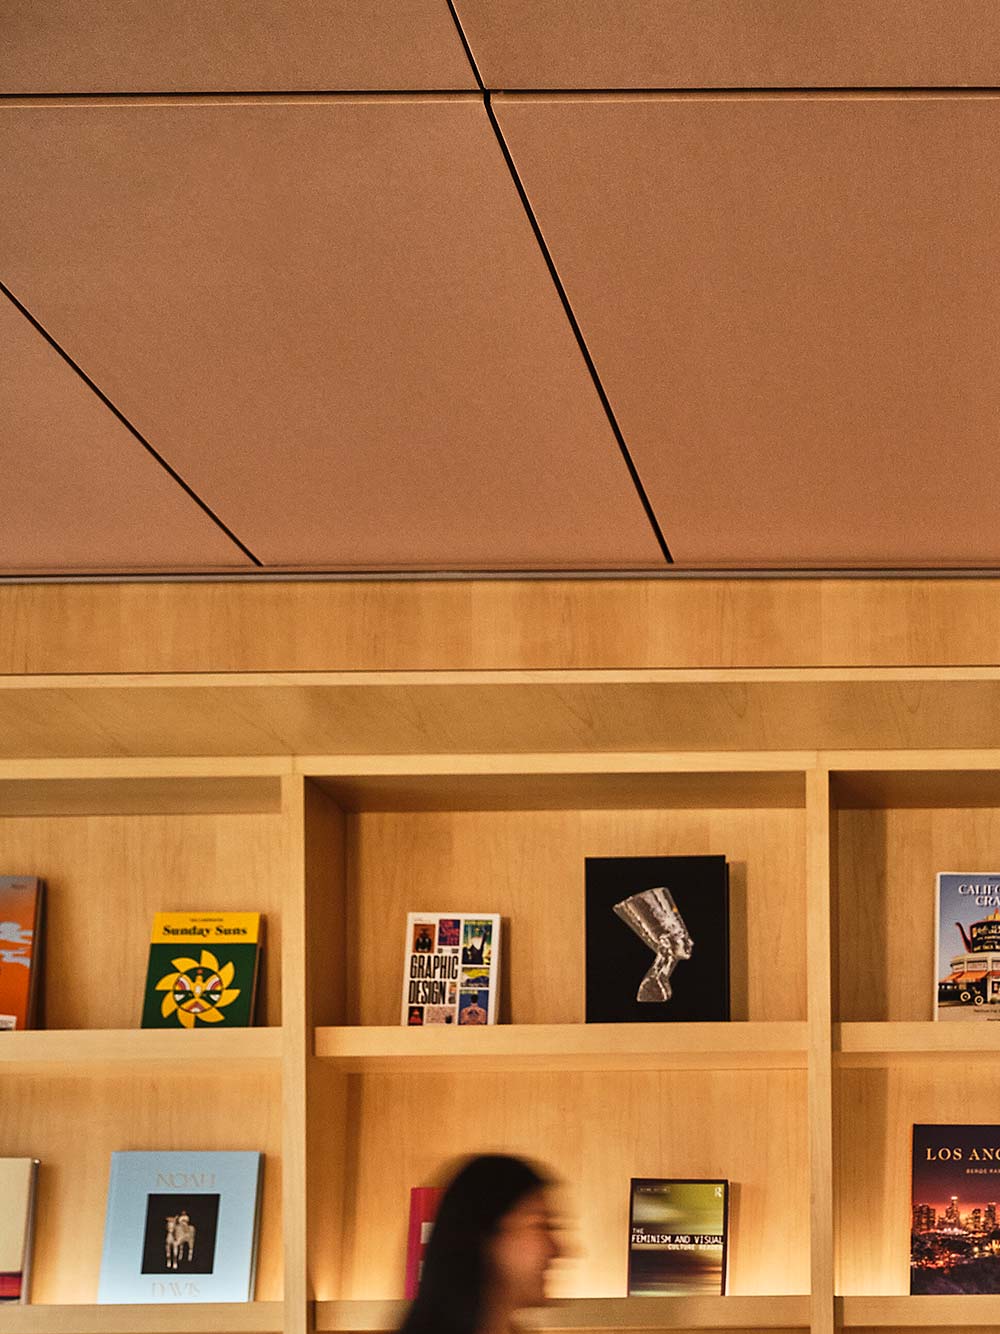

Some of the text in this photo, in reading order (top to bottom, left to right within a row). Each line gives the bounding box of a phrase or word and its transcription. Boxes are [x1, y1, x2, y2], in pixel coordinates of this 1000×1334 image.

[162, 925, 247, 938] Sunday Suns
[410, 955, 459, 979] GRAPHIC
[408, 980, 446, 1004] DESIGN
[926, 1147, 962, 1161] LOS
[156, 1172, 217, 1188] NOAH
[631, 1234, 724, 1244] FEMINISM AND VISUAL
